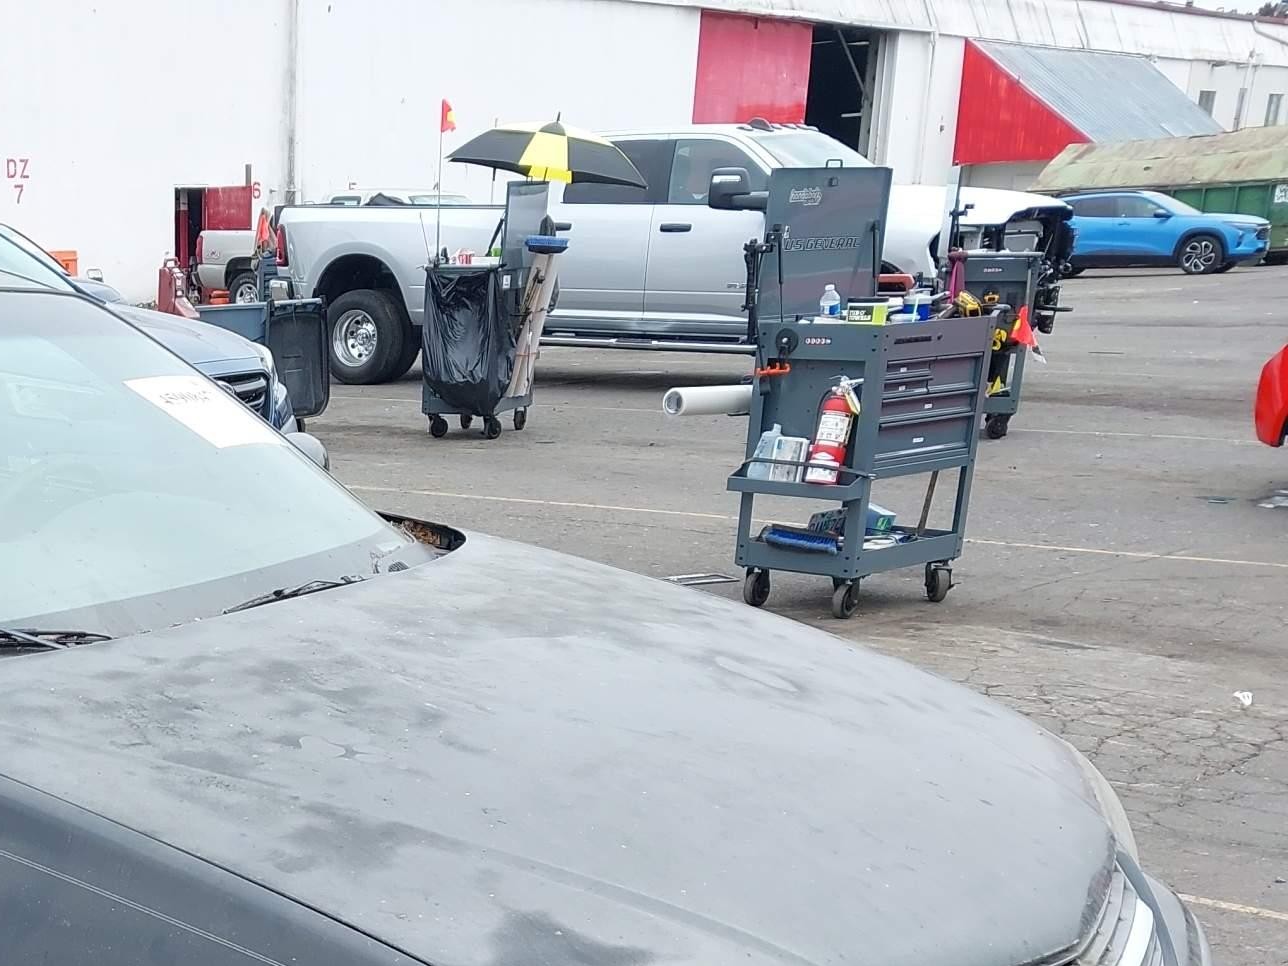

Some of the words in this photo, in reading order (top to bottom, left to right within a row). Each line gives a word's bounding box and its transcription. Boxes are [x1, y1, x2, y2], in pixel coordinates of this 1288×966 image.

[6, 158, 30, 179] DZ
[14, 184, 24, 205] 7
[252, 181, 261, 199] 6
